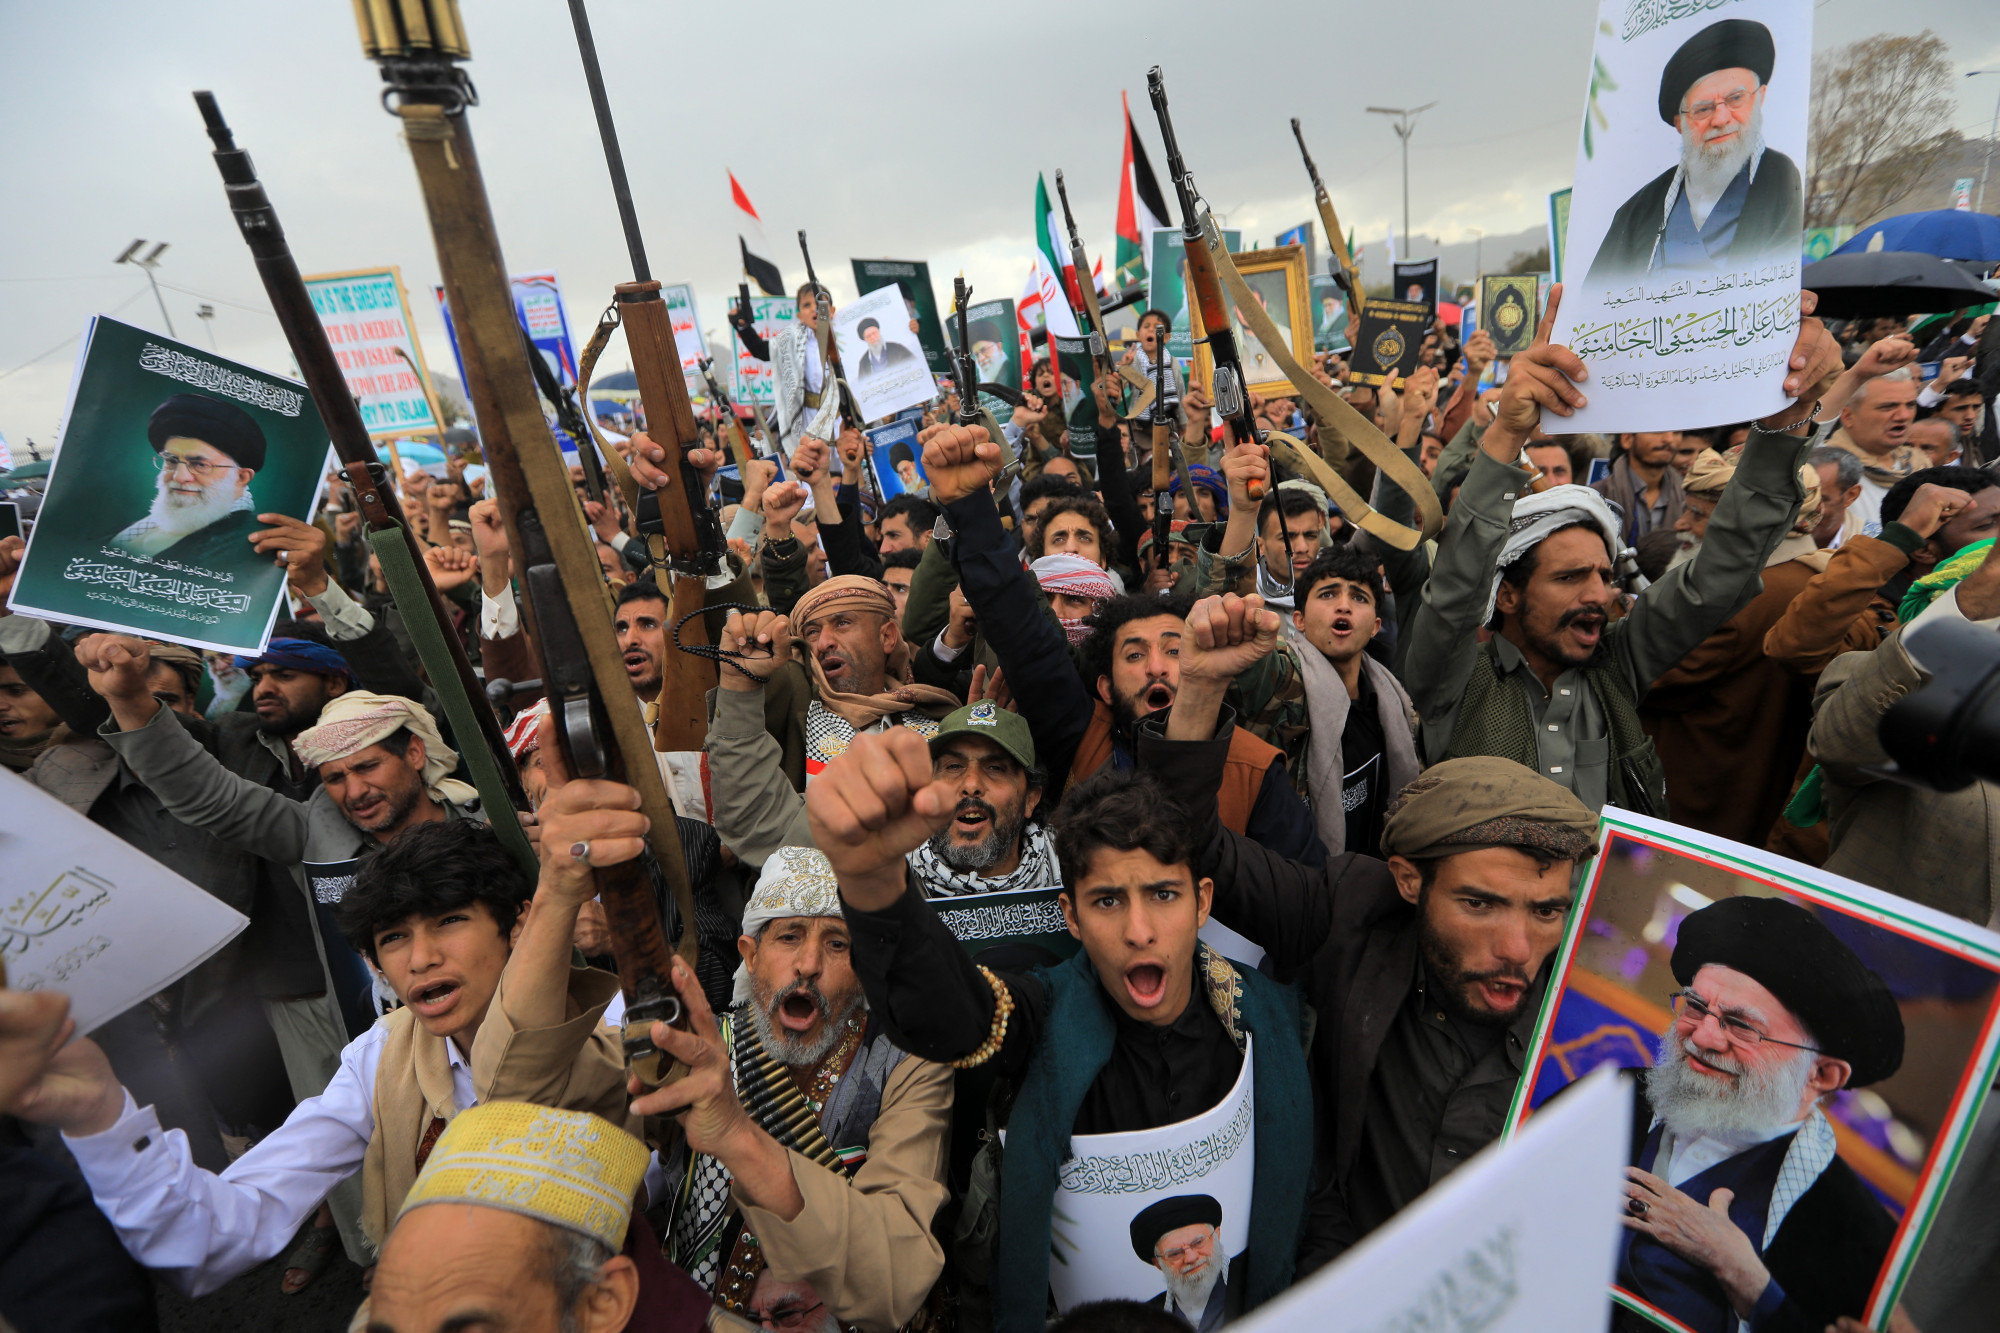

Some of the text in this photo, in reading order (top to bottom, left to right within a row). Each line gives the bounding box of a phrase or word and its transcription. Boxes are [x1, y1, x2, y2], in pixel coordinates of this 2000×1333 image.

[322, 287, 337, 314] IS
[332, 285, 355, 312] THE
[352, 281, 398, 311] GREATEST
[342, 323, 359, 342] TO
[359, 319, 405, 341] AMERICA
[351, 350, 367, 369] TO
[351, 376, 378, 396] UPON
[376, 373, 397, 394] THE
[380, 402, 396, 423] TO
[395, 398, 429, 421] ISLAM
